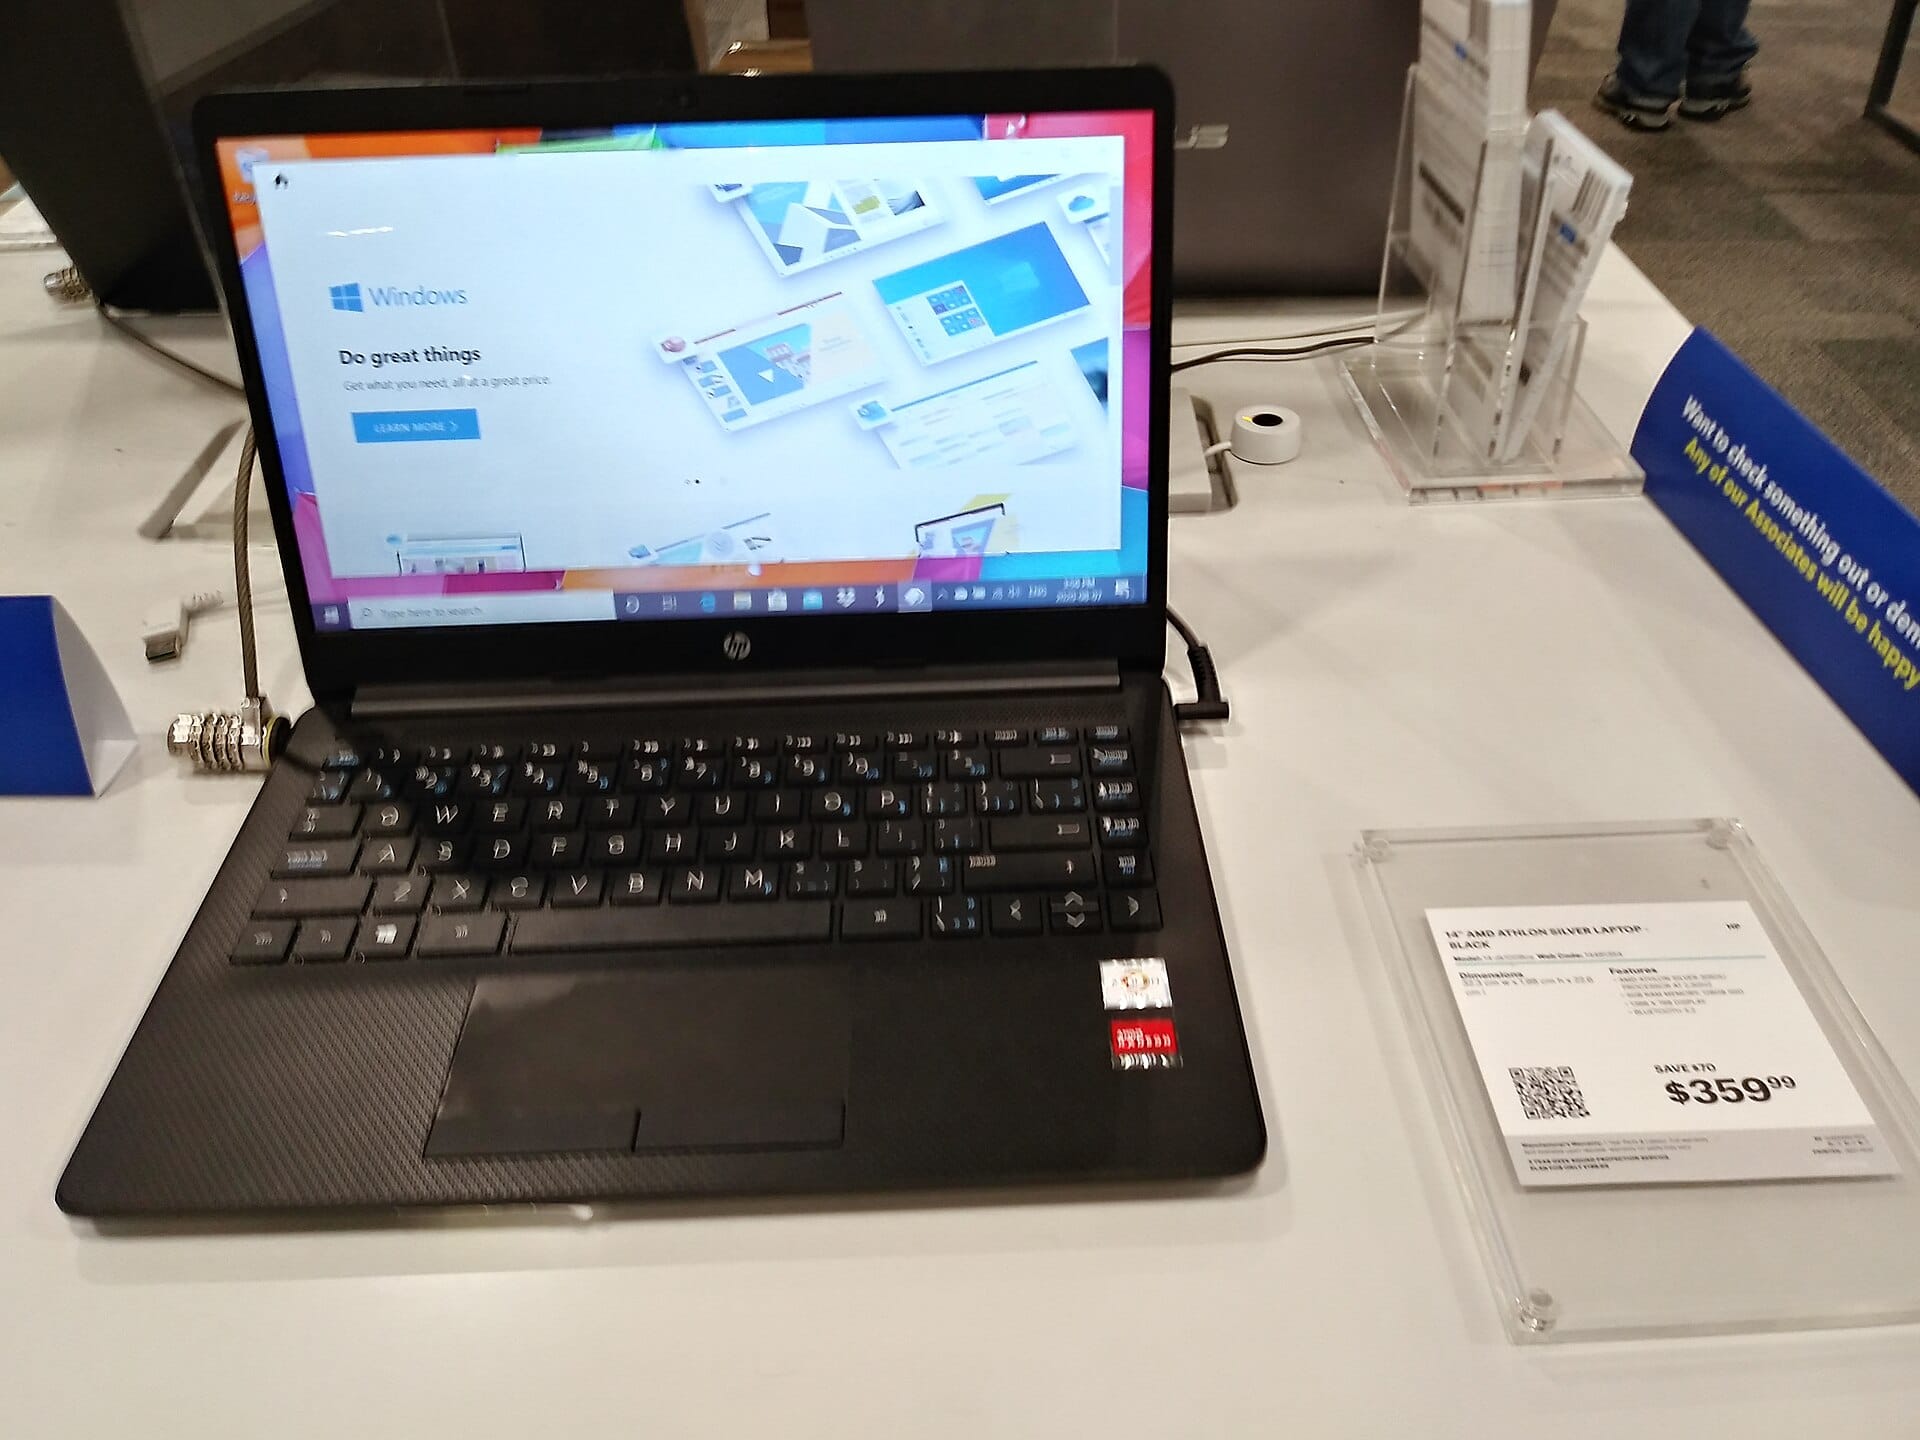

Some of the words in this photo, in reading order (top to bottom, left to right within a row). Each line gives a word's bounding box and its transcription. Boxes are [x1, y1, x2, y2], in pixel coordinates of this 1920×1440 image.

[367, 285, 469, 307] Windows
[339, 350, 366, 366] Do
[371, 347, 420, 368] great
[423, 346, 482, 366] things
[344, 380, 363, 391] Get
[367, 379, 393, 390] what
[395, 380, 417, 392] you
[452, 376, 465, 388] all
[467, 377, 479, 388] at
[490, 376, 520, 389] great
[373, 422, 409, 433] LEARN
[411, 421, 445, 432] MORE
[1682, 394, 1718, 441] Want
[1712, 426, 1730, 454] to
[1727, 444, 1769, 492] check
[1763, 480, 1841, 568] something
[1838, 553, 1870, 592] out
[1865, 581, 1889, 609] or
[1684, 436, 1712, 475] Any
[1708, 463, 1729, 488] of
[1722, 478, 1749, 509] our
[1745, 497, 1818, 583] Associates
[1816, 571, 1850, 612] will
[1844, 595, 1869, 635] be
[1866, 619, 1920, 691] happy
[379, 608, 404, 620] Type
[407, 606, 432, 618] here
[447, 605, 484, 617] search
[435, 804, 460, 825] W
[492, 802, 509, 823] E
[548, 800, 564, 821] R
[606, 799, 620, 818] T
[659, 797, 676, 816] Y
[715, 795, 731, 815] U
[880, 790, 895, 809] P
[493, 839, 510, 859] D
[551, 836, 567, 857] F
[665, 832, 682, 852] H
[724, 832, 738, 851] J
[779, 829, 795, 849] K
[837, 827, 850, 848] L
[452, 879, 471, 900] X
[570, 874, 588, 895] V
[628, 872, 644, 894] B
[686, 870, 704, 891] N
[744, 868, 763, 889] M
[1467, 928, 1496, 938] AMD
[1498, 927, 1549, 938] ATHLON
[1550, 926, 1592, 937] SILVER
[1592, 924, 1642, 936] LAPTOP
[1448, 940, 1491, 950] BLACK
[1459, 971, 1525, 980] Dimensions
[1608, 967, 1658, 976] Features
[1654, 1063, 1690, 1075] SAVE
[1692, 1063, 1718, 1074] $70
